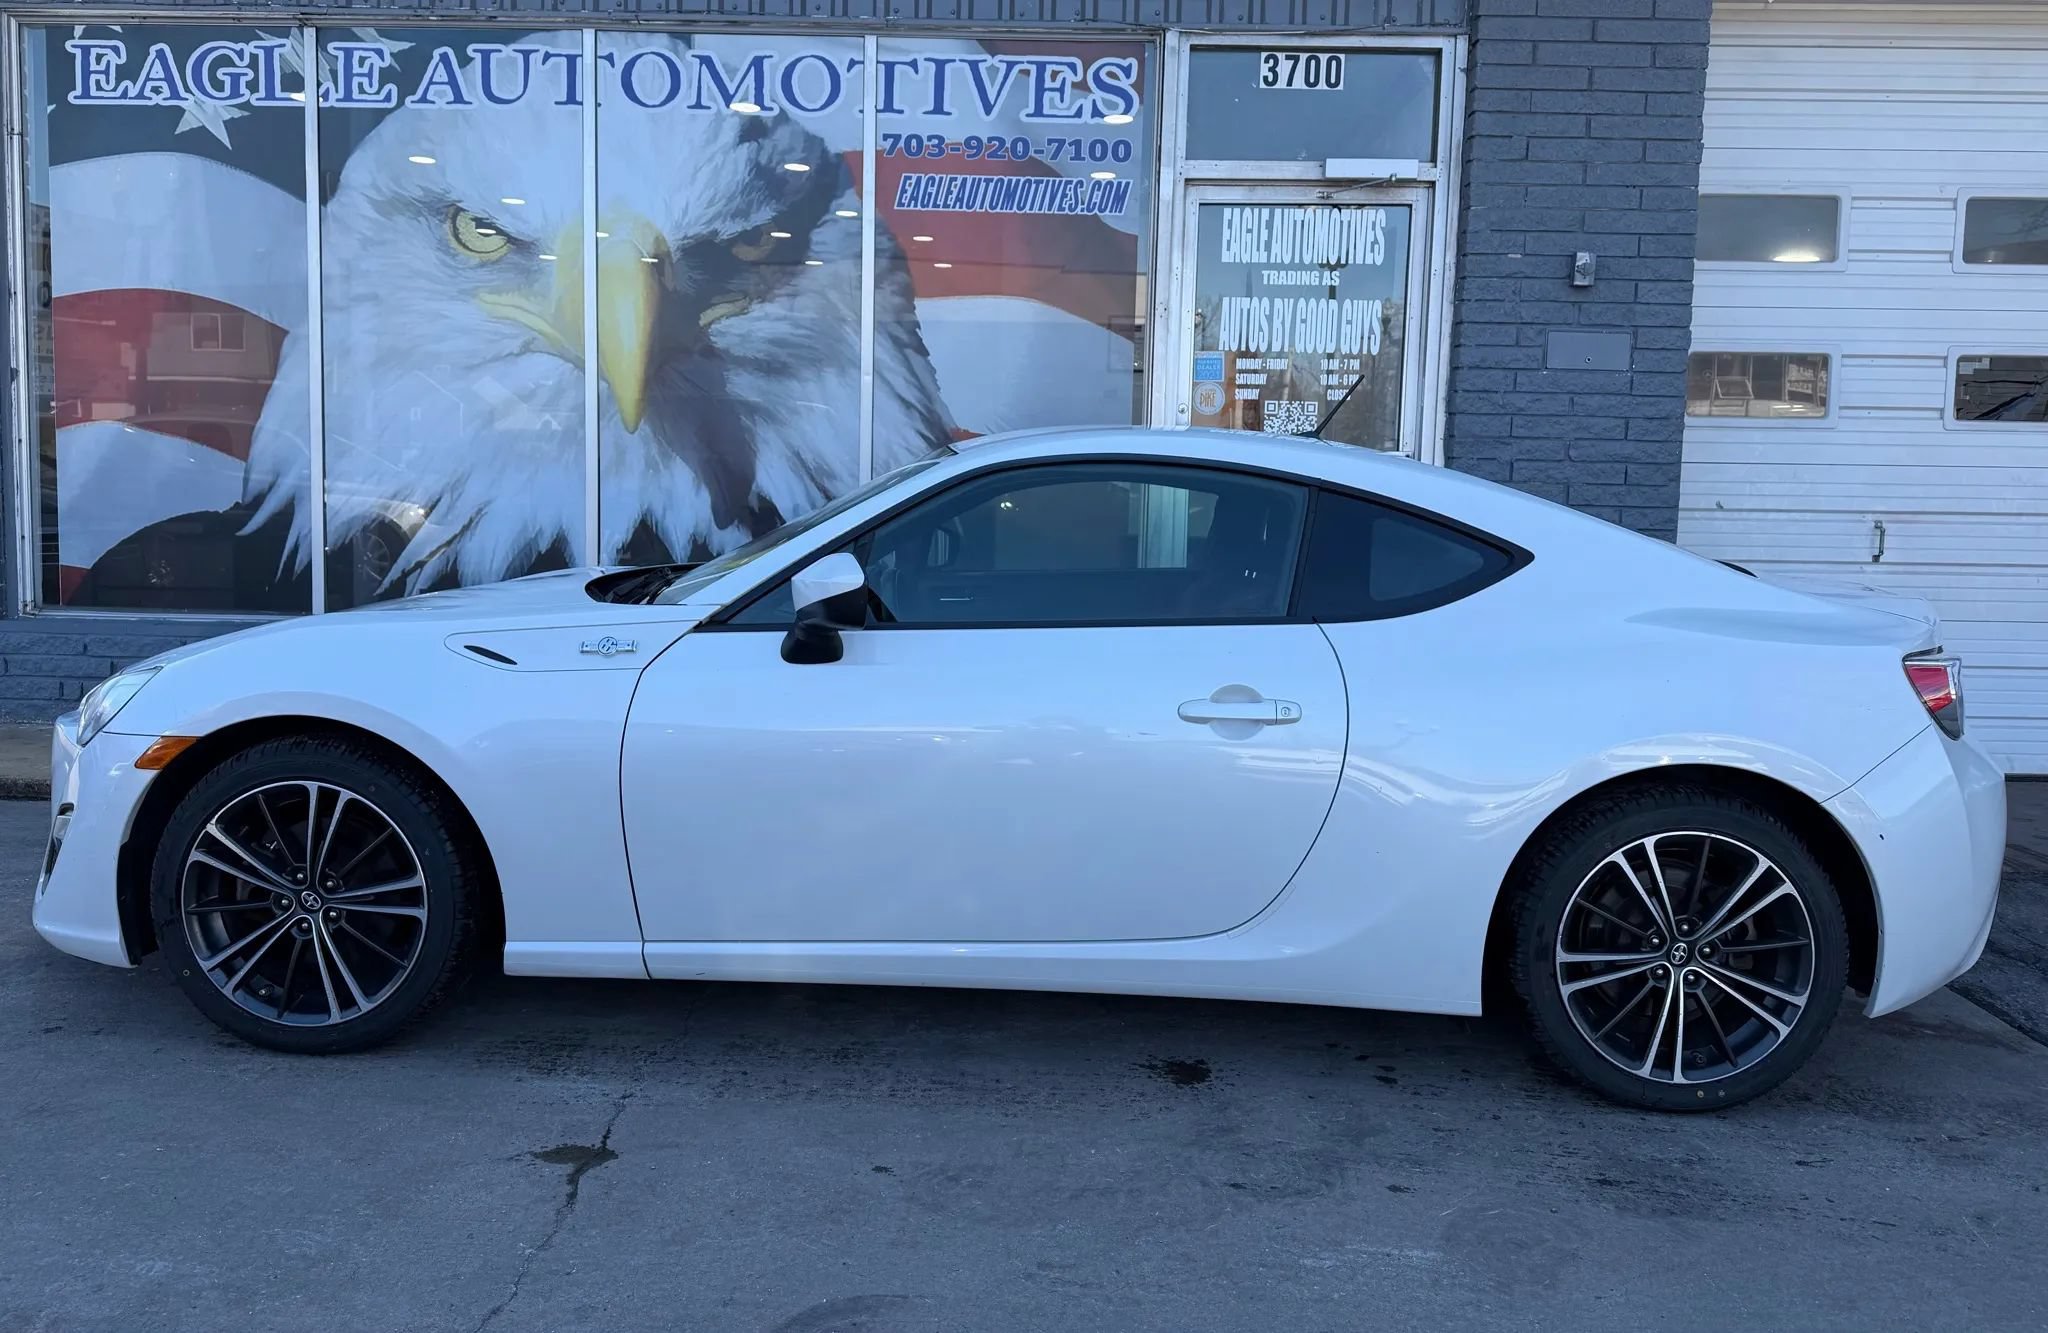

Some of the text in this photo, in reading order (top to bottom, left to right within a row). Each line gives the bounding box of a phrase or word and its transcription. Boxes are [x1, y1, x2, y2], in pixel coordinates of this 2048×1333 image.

[67, 40, 1137, 124] EAGLE AUTOMOTIVES
[1262, 53, 1342, 89] 3700
[882, 133, 1133, 163] 703-920-7100
[894, 173, 1132, 216] EAGLEAUTOMOTIVES.COM
[1221, 207, 1386, 266] EAGLE AUTOMOTIVES
[1262, 270, 1340, 286] TRADING AS
[1218, 296, 1382, 356] AUTOS BY GOOD GUYS
[1235, 373, 1268, 385] SATURDAY
[1319, 374, 1328, 386] 10
[1327, 374, 1339, 386] AM
[1343, 374, 1348, 386] 6
[1236, 358, 1263, 370] MONDAY
[1266, 358, 1289, 370] FRIDAY
[1320, 358, 1328, 370] 10
[1328, 358, 1340, 370] AM
[1343, 358, 1348, 370] 7
[1349, 358, 1360, 370] PM
[1234, 388, 1351, 401] SUNDAY CLOS
